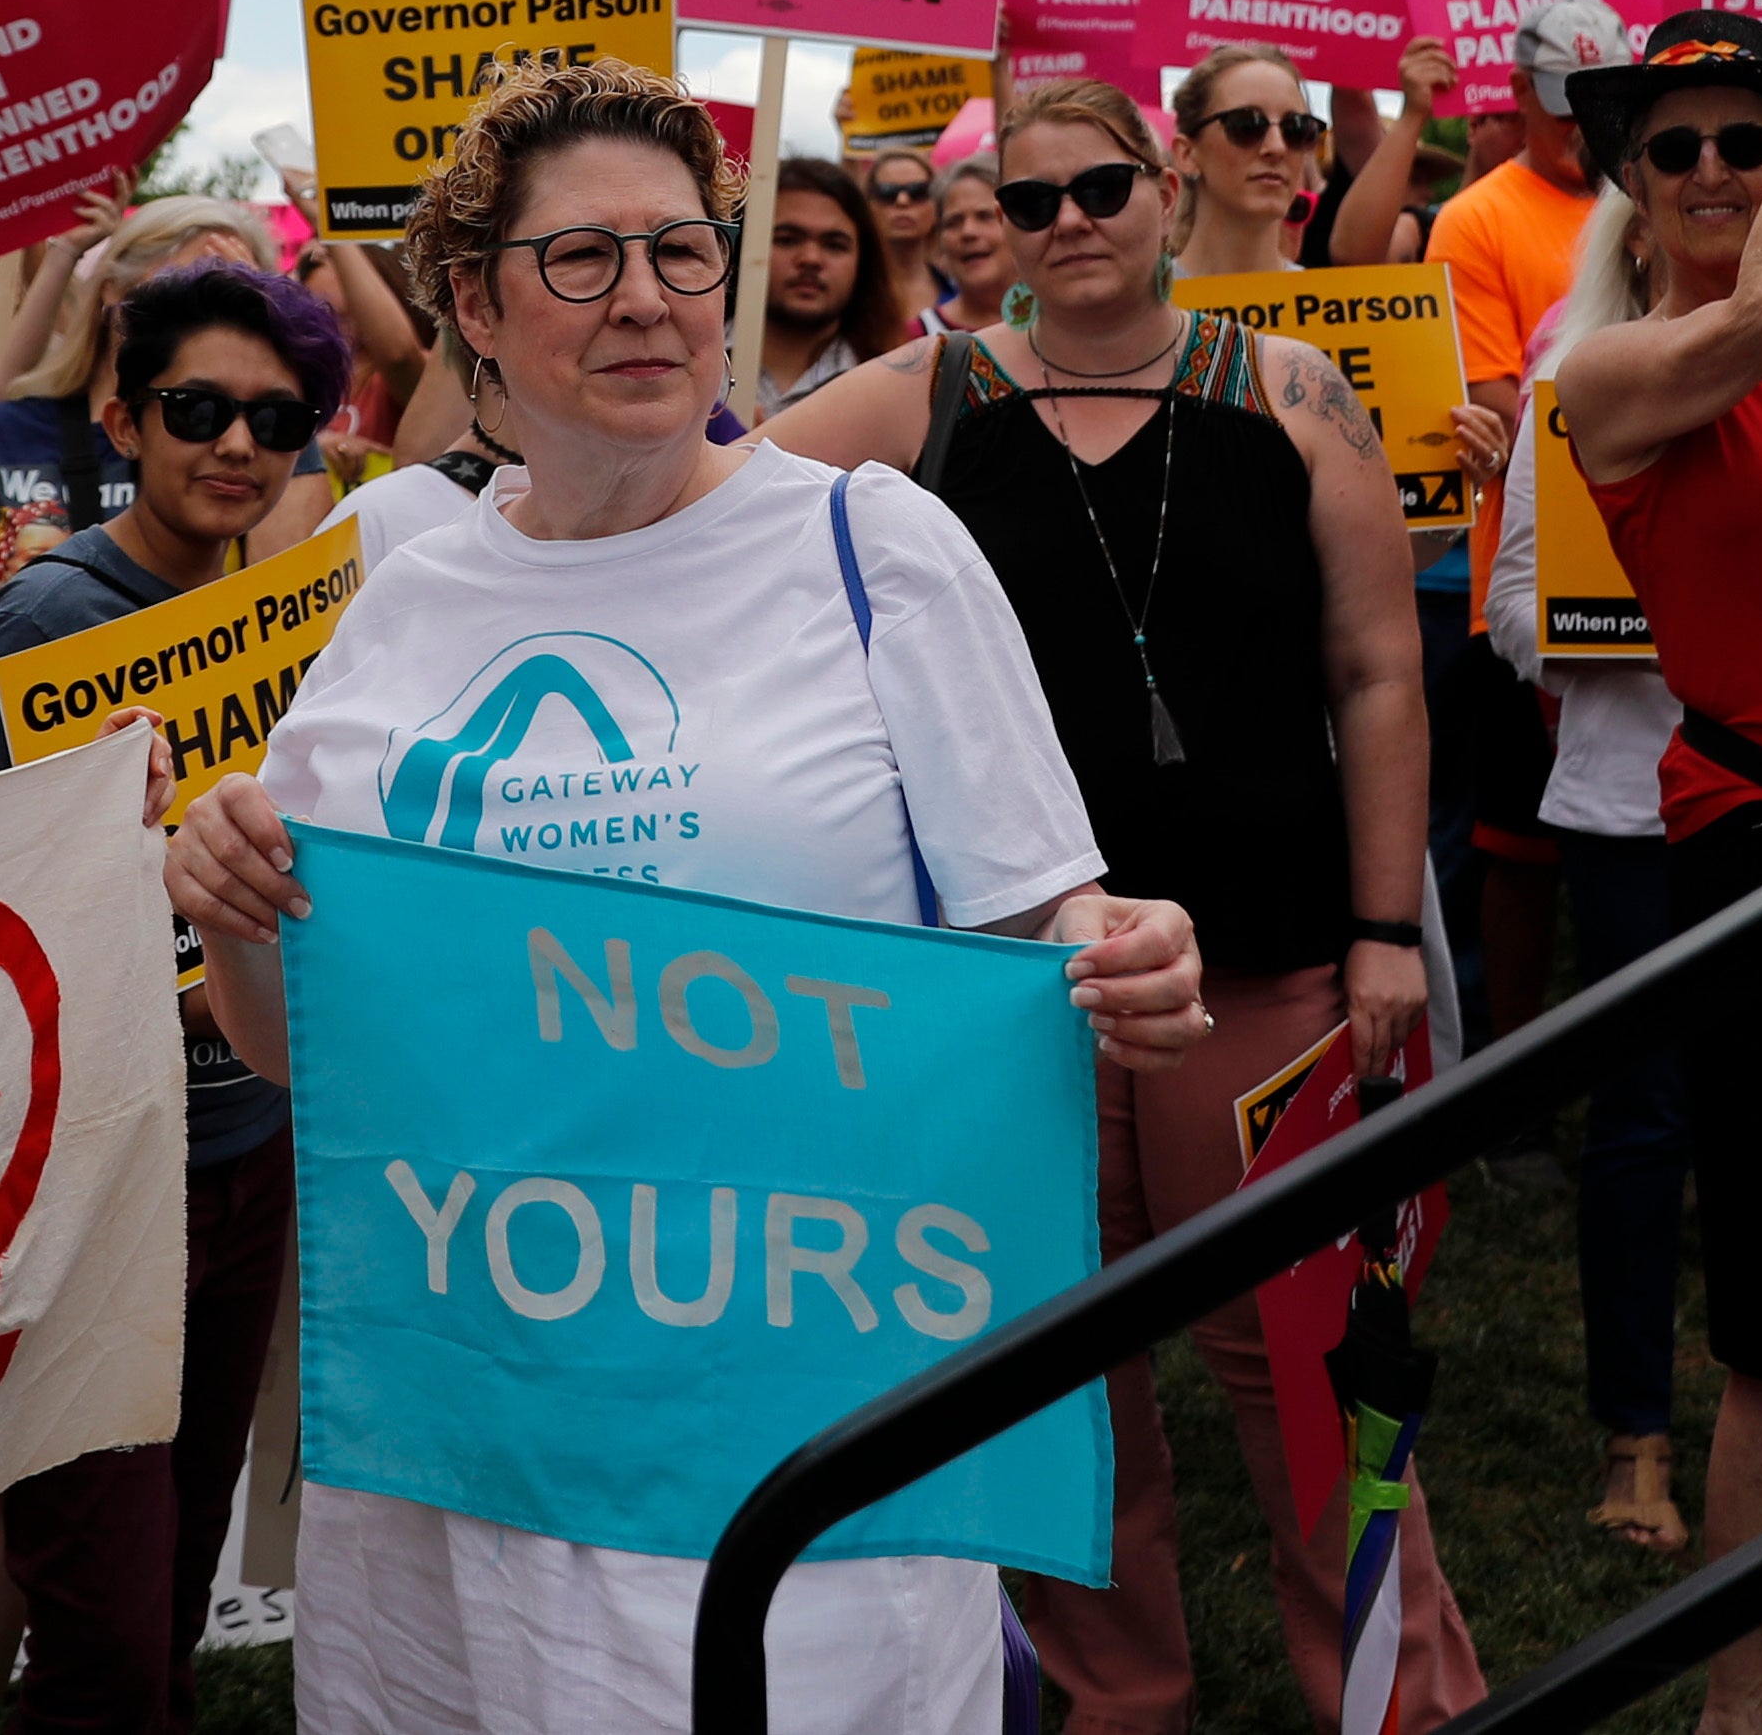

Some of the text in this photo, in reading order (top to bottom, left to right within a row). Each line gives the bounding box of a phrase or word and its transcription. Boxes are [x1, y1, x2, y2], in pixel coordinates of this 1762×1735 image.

[872, 63, 966, 95] SHAME
[878, 101, 910, 122] on
[330, 200, 390, 222] When
[1295, 292, 1440, 328] Parson
[1552, 611, 1617, 635] When
[20, 553, 361, 733] Governor Parson
[500, 763, 702, 804] GATEWAY
[500, 810, 701, 854] WOMEN'S
[526, 925, 891, 1090] NOT
[382, 1158, 993, 1342] YOURS
